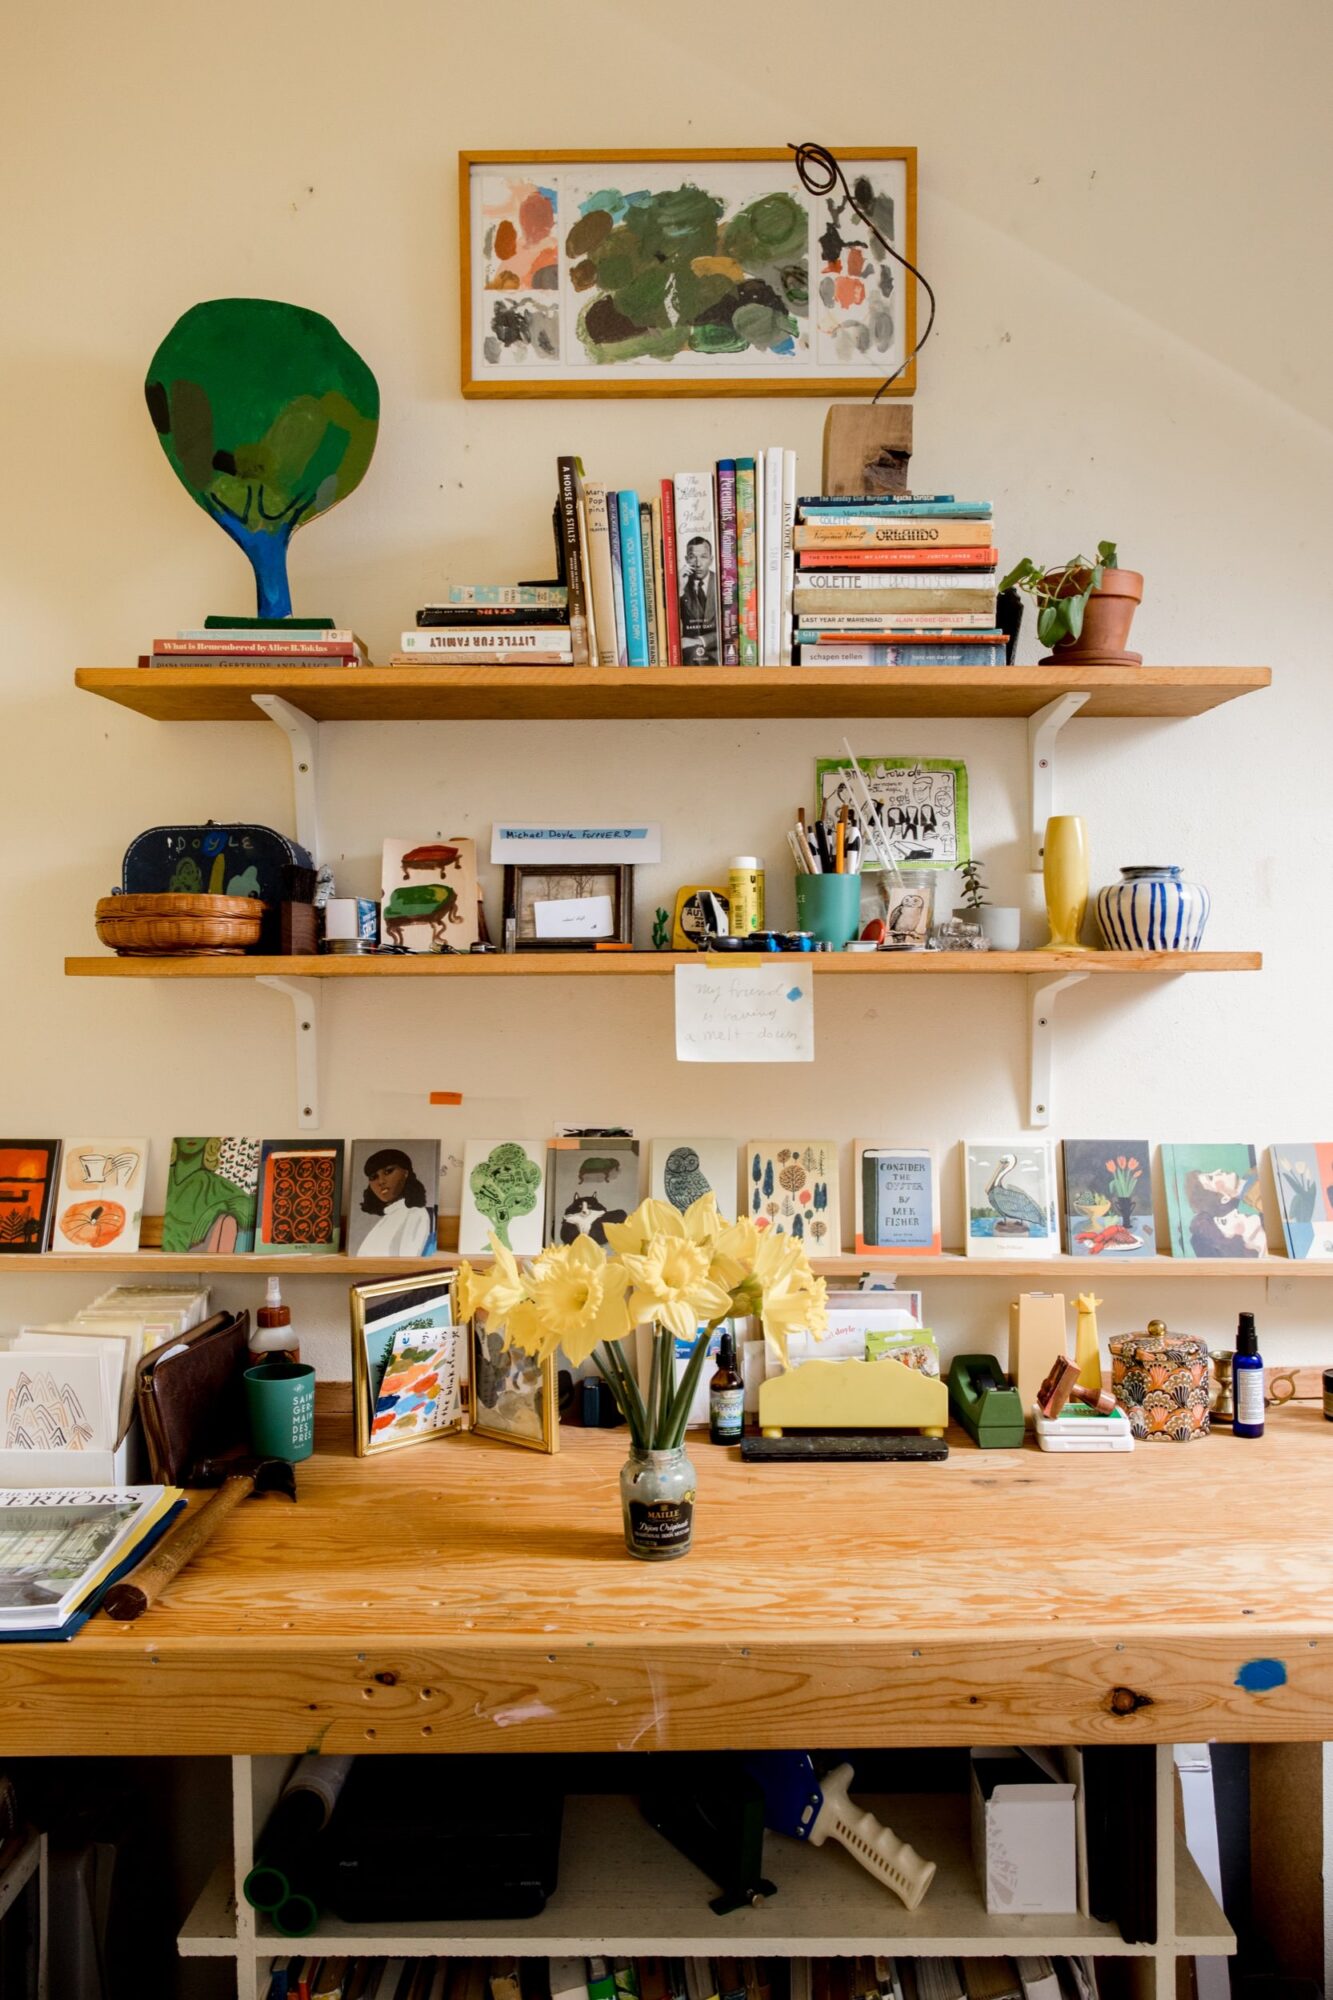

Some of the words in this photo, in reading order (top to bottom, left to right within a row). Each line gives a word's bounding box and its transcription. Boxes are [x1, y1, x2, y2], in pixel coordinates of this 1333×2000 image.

[563, 474, 573, 501] HOUSE
[721, 477, 735, 521] Perennials
[566, 504, 574, 516] ON
[567, 518, 576, 543] STILTS
[876, 529, 939, 541] ORLANDO
[626, 537, 635, 554] YOU
[722, 529, 735, 569] Washington
[809, 575, 861, 588] COLETTE
[723, 579, 735, 604] Oregon
[645, 578, 654, 622] Selfishness
[430, 637, 470, 647] FAMILY
[473, 636, 494, 647] FUR
[497, 636, 536, 646] LITTLE
[163, 642, 186, 650] What
[188, 642, 195, 650] is
[197, 642, 255, 651] Remembered
[255, 643, 267, 653] by
[267, 644, 289, 652] Alice
[809, 653, 840, 662] schapen
[506, 830, 543, 839] Michael
[549, 830, 576, 839] Doyle
[728, 977, 784, 998] friend
[723, 1008, 777, 1021] having
[880, 1163, 926, 1172] CONSIDER
[892, 1173, 911, 1181] THE
[885, 1182, 924, 1191] OYSTER
[885, 1217, 920, 1226] FISHER
[834, 1325, 855, 1336] doyle
[292, 1411, 313, 1424] MAIN
[292, 1422, 309, 1434] DES
[0, 1492, 140, 1506] ERIORS
[647, 1509, 680, 1519] MAILLE
